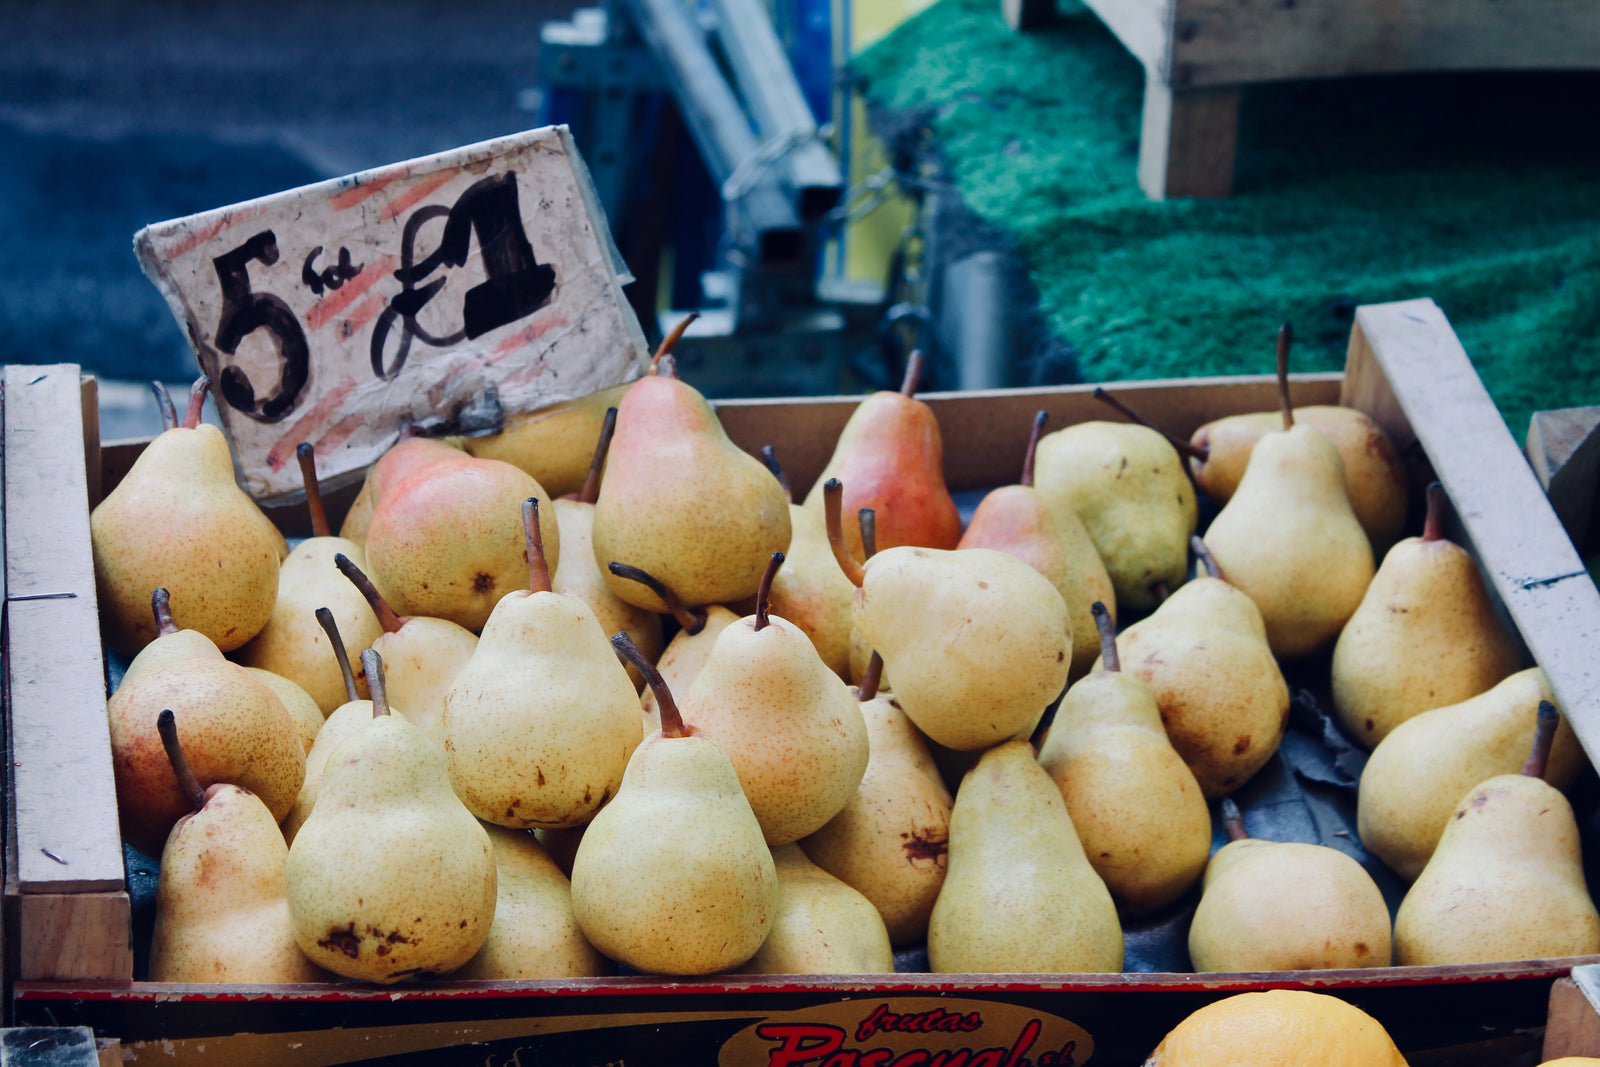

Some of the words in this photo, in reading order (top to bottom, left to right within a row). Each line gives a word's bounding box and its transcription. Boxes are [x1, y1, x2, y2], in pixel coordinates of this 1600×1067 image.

[213, 229, 309, 424] 5
[370, 171, 556, 381] £1
[855, 1003, 984, 1042] frutas
